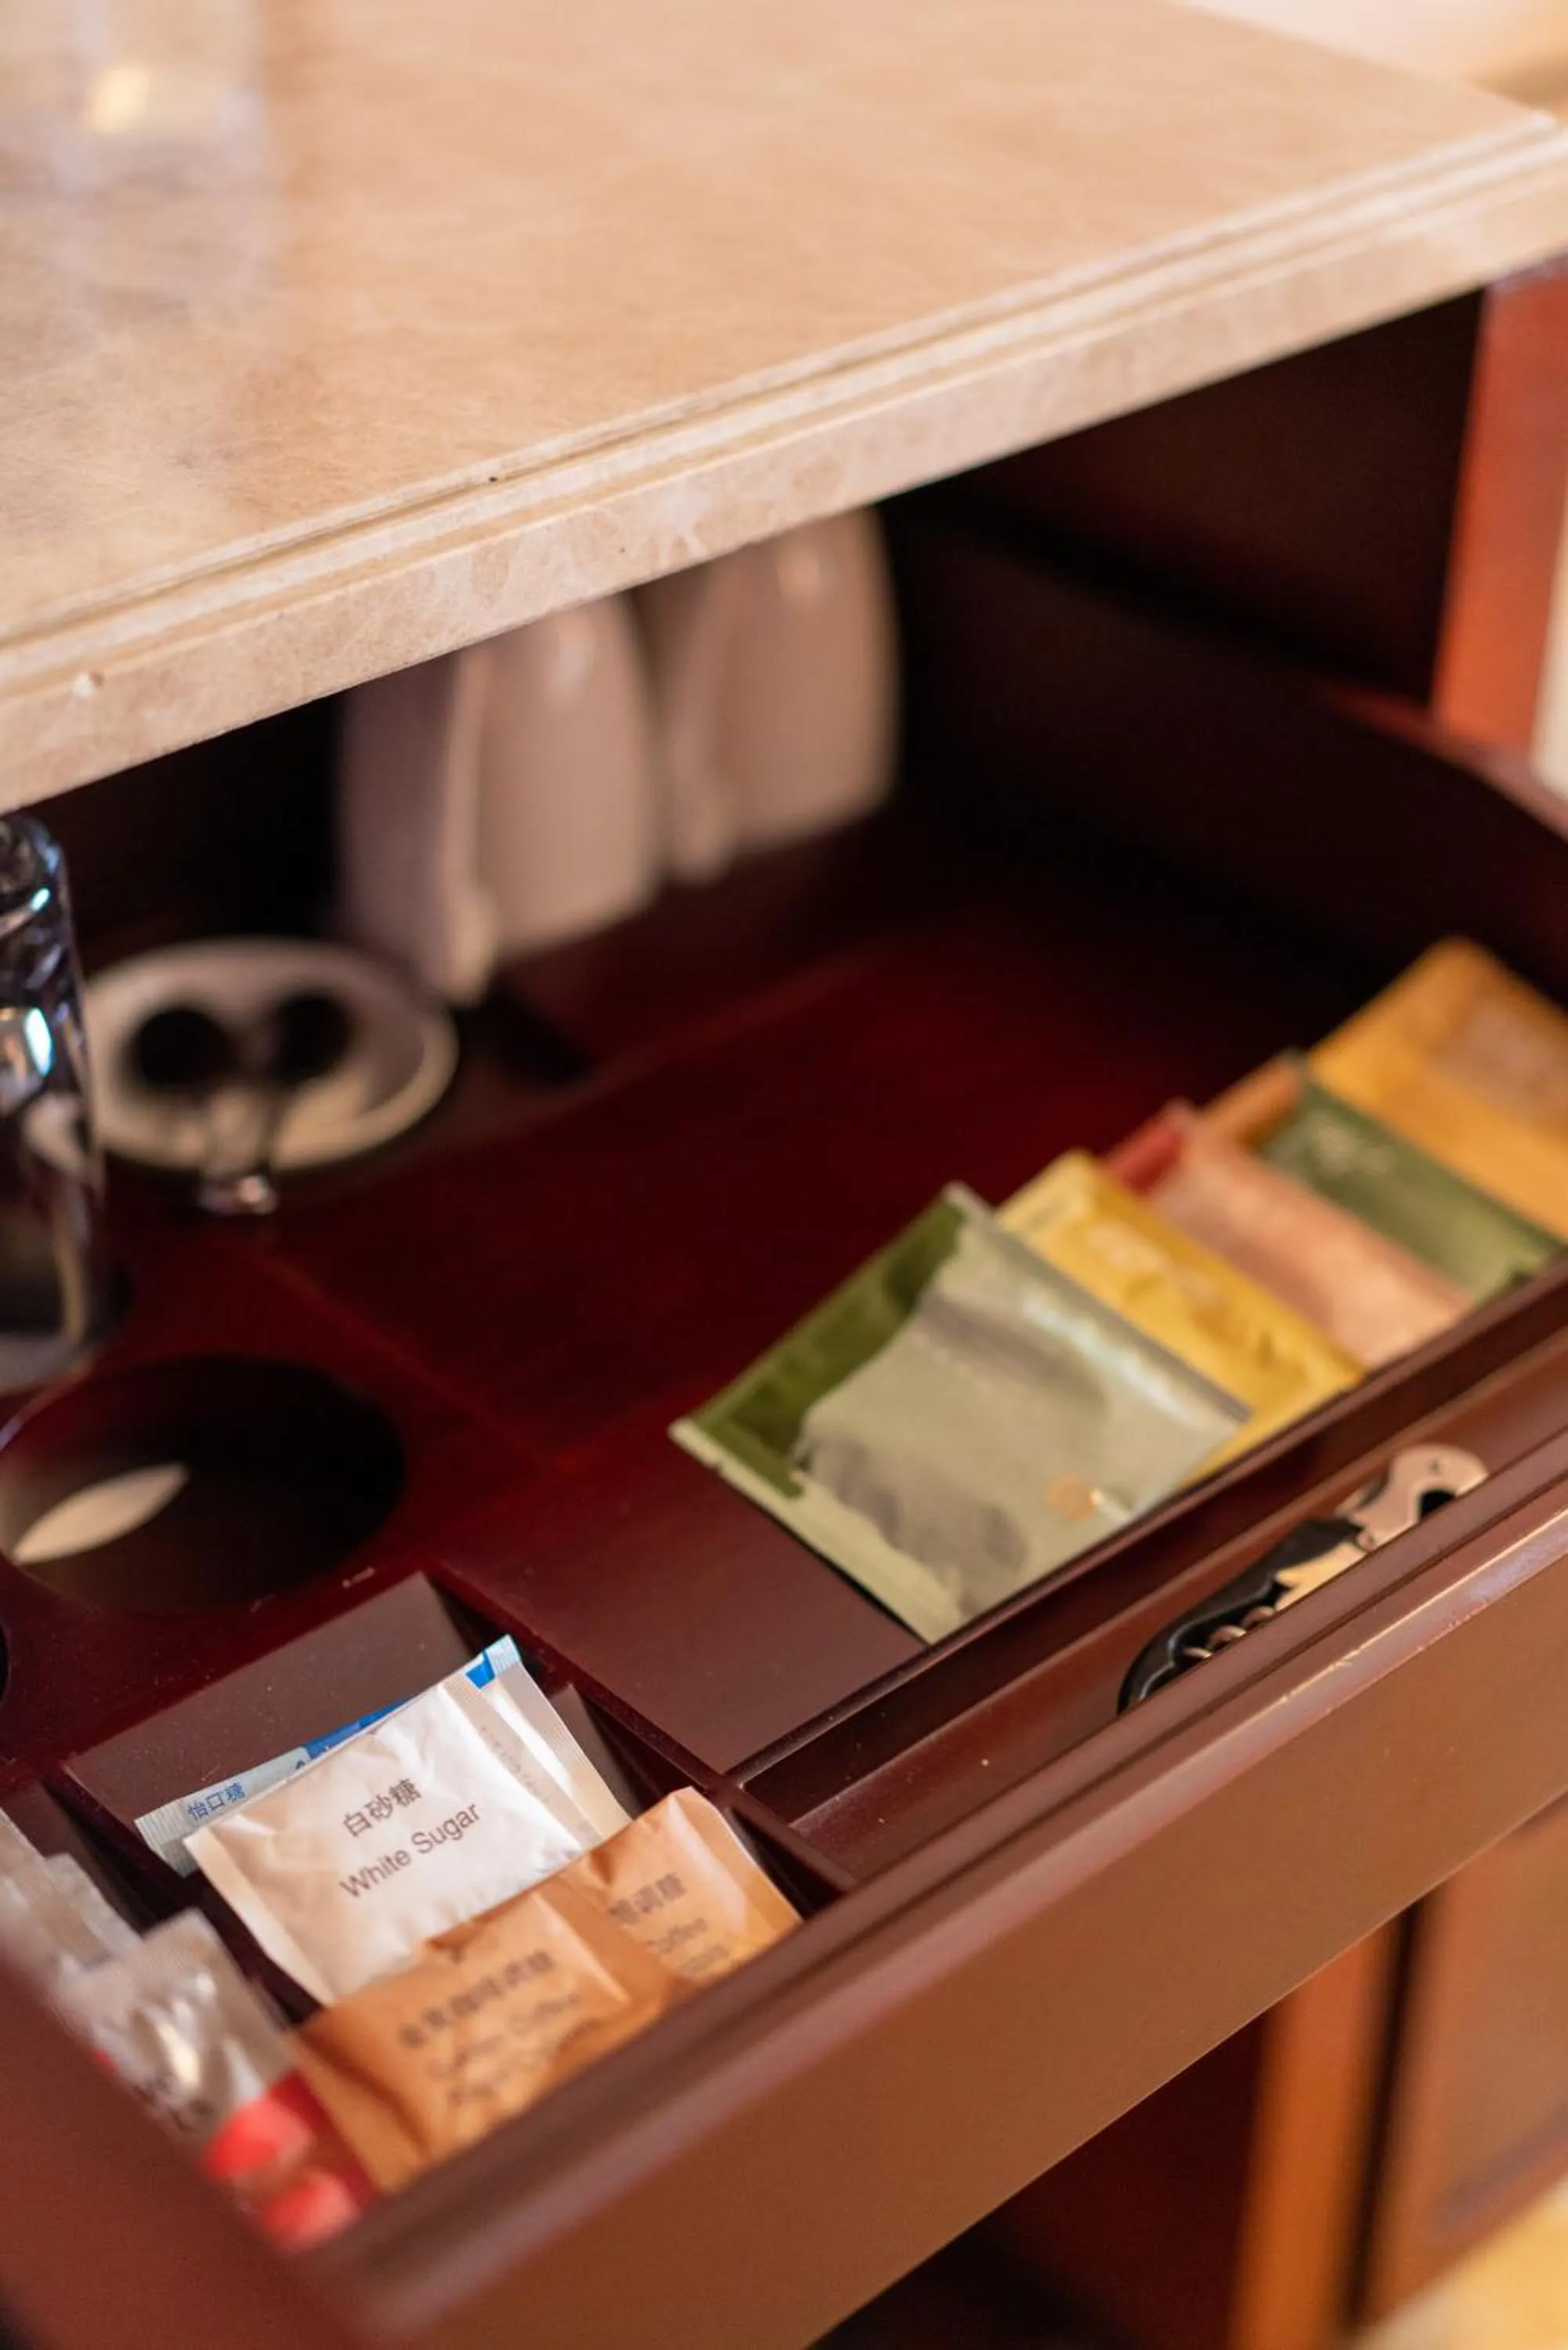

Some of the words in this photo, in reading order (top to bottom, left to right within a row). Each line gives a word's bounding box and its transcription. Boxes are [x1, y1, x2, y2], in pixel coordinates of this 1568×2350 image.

[342, 1778, 422, 1838] 白砂糖
[338, 1849, 412, 1898] White
[410, 1803, 481, 1854] Sugar
